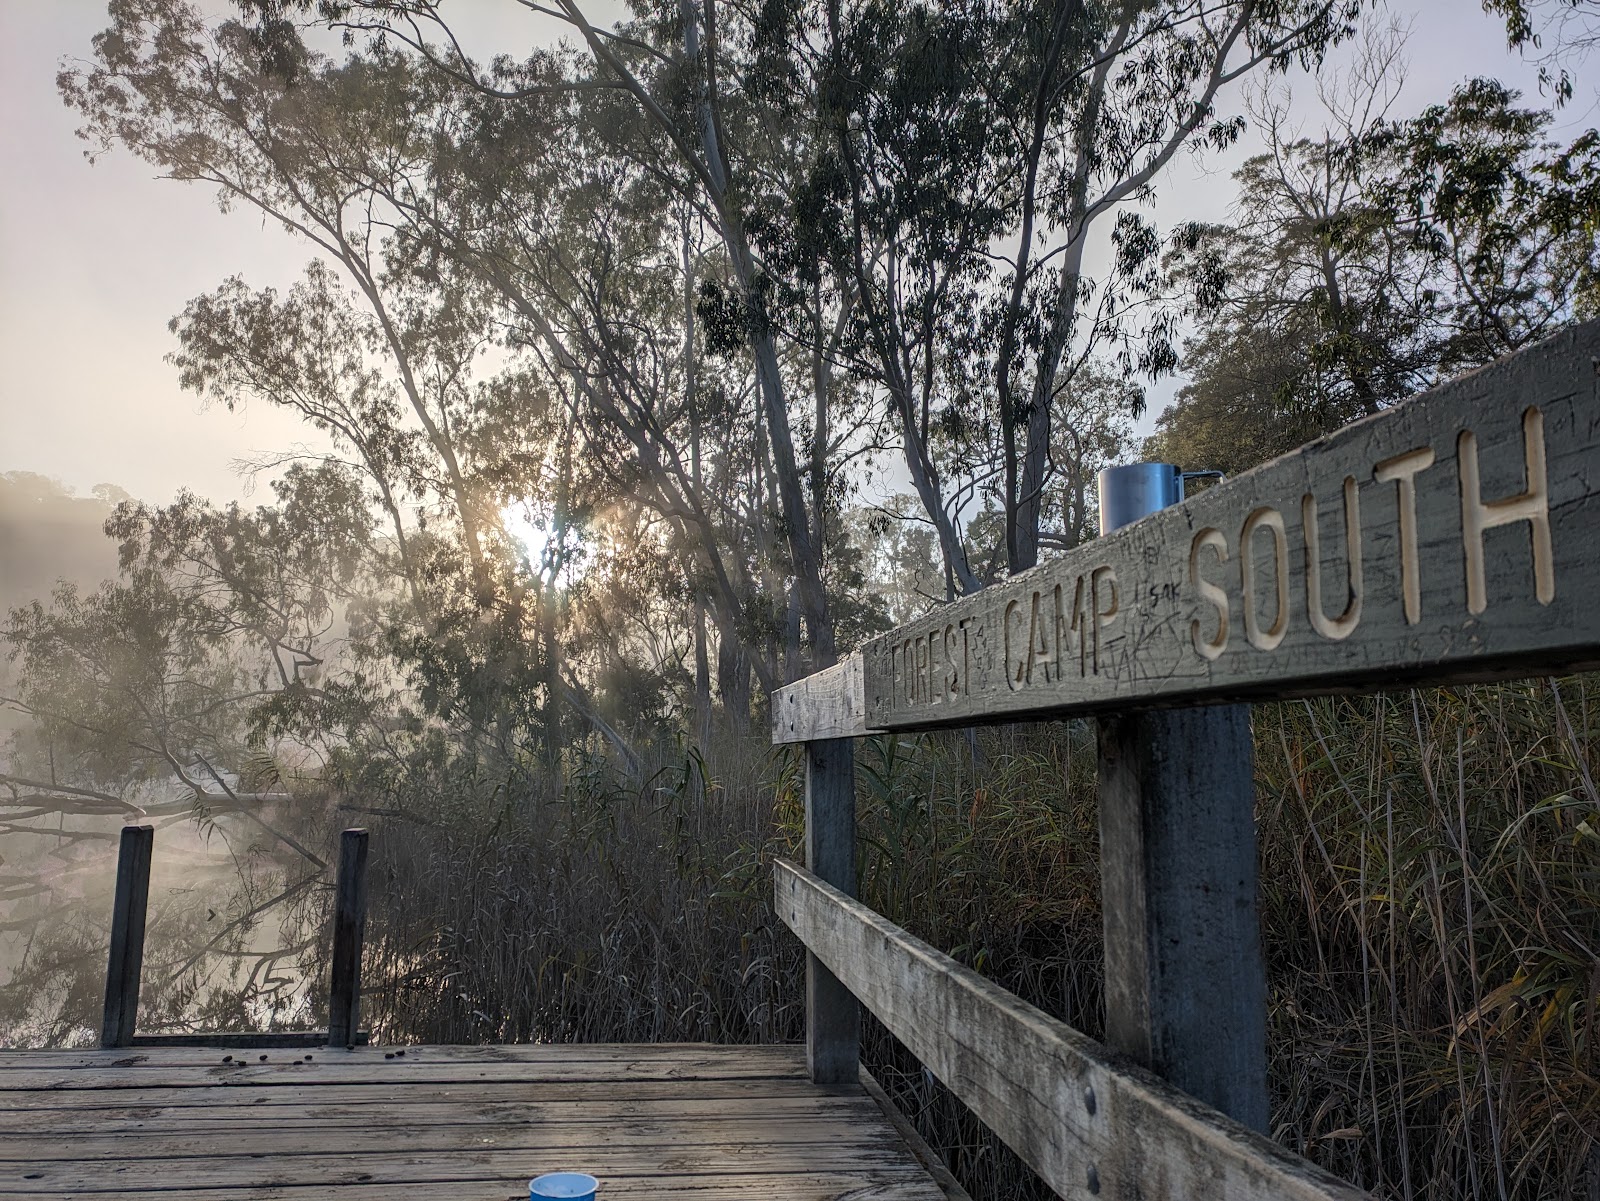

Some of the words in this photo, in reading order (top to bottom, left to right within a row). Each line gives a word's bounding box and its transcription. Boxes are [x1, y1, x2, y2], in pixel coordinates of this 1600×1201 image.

[891, 616, 974, 709] FOREST
[1004, 565, 1119, 692] CAMP
[1190, 405, 1555, 661] SOUTH
